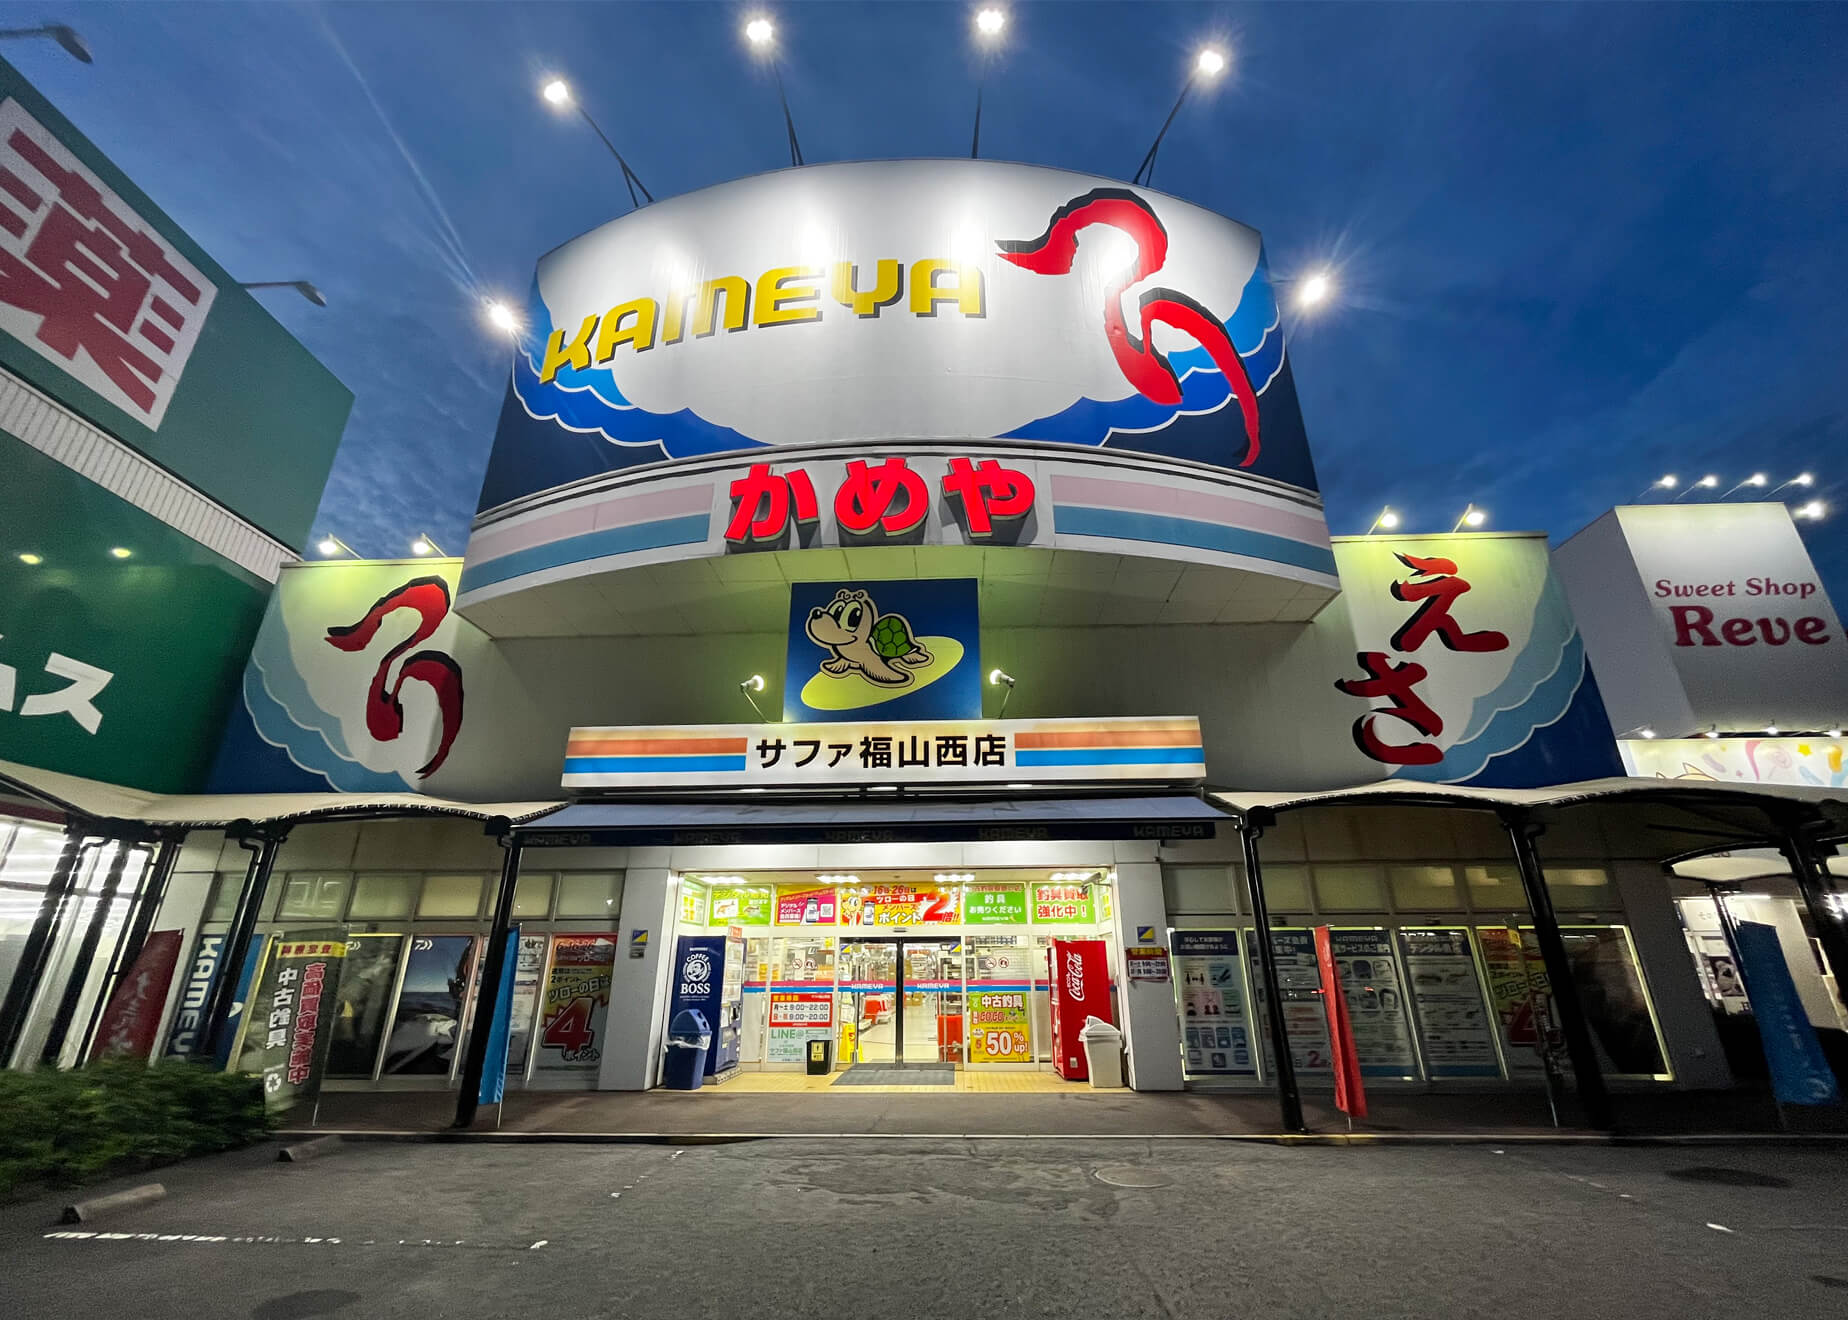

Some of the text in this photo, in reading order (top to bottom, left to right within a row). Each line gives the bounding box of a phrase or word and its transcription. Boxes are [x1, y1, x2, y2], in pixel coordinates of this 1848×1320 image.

[539, 258, 987, 385] KAMEYA
[724, 457, 1036, 543] かめや
[1654, 577, 1817, 599] Sweet Shop
[1668, 605, 1831, 647] Reve
[1334, 552, 1510, 766] えさ
[756, 734, 1006, 768] サファ福山西店
[680, 982, 711, 994] BOSS
[981, 993, 1024, 1009] 中古釣具
[541, 995, 595, 1049] 4
